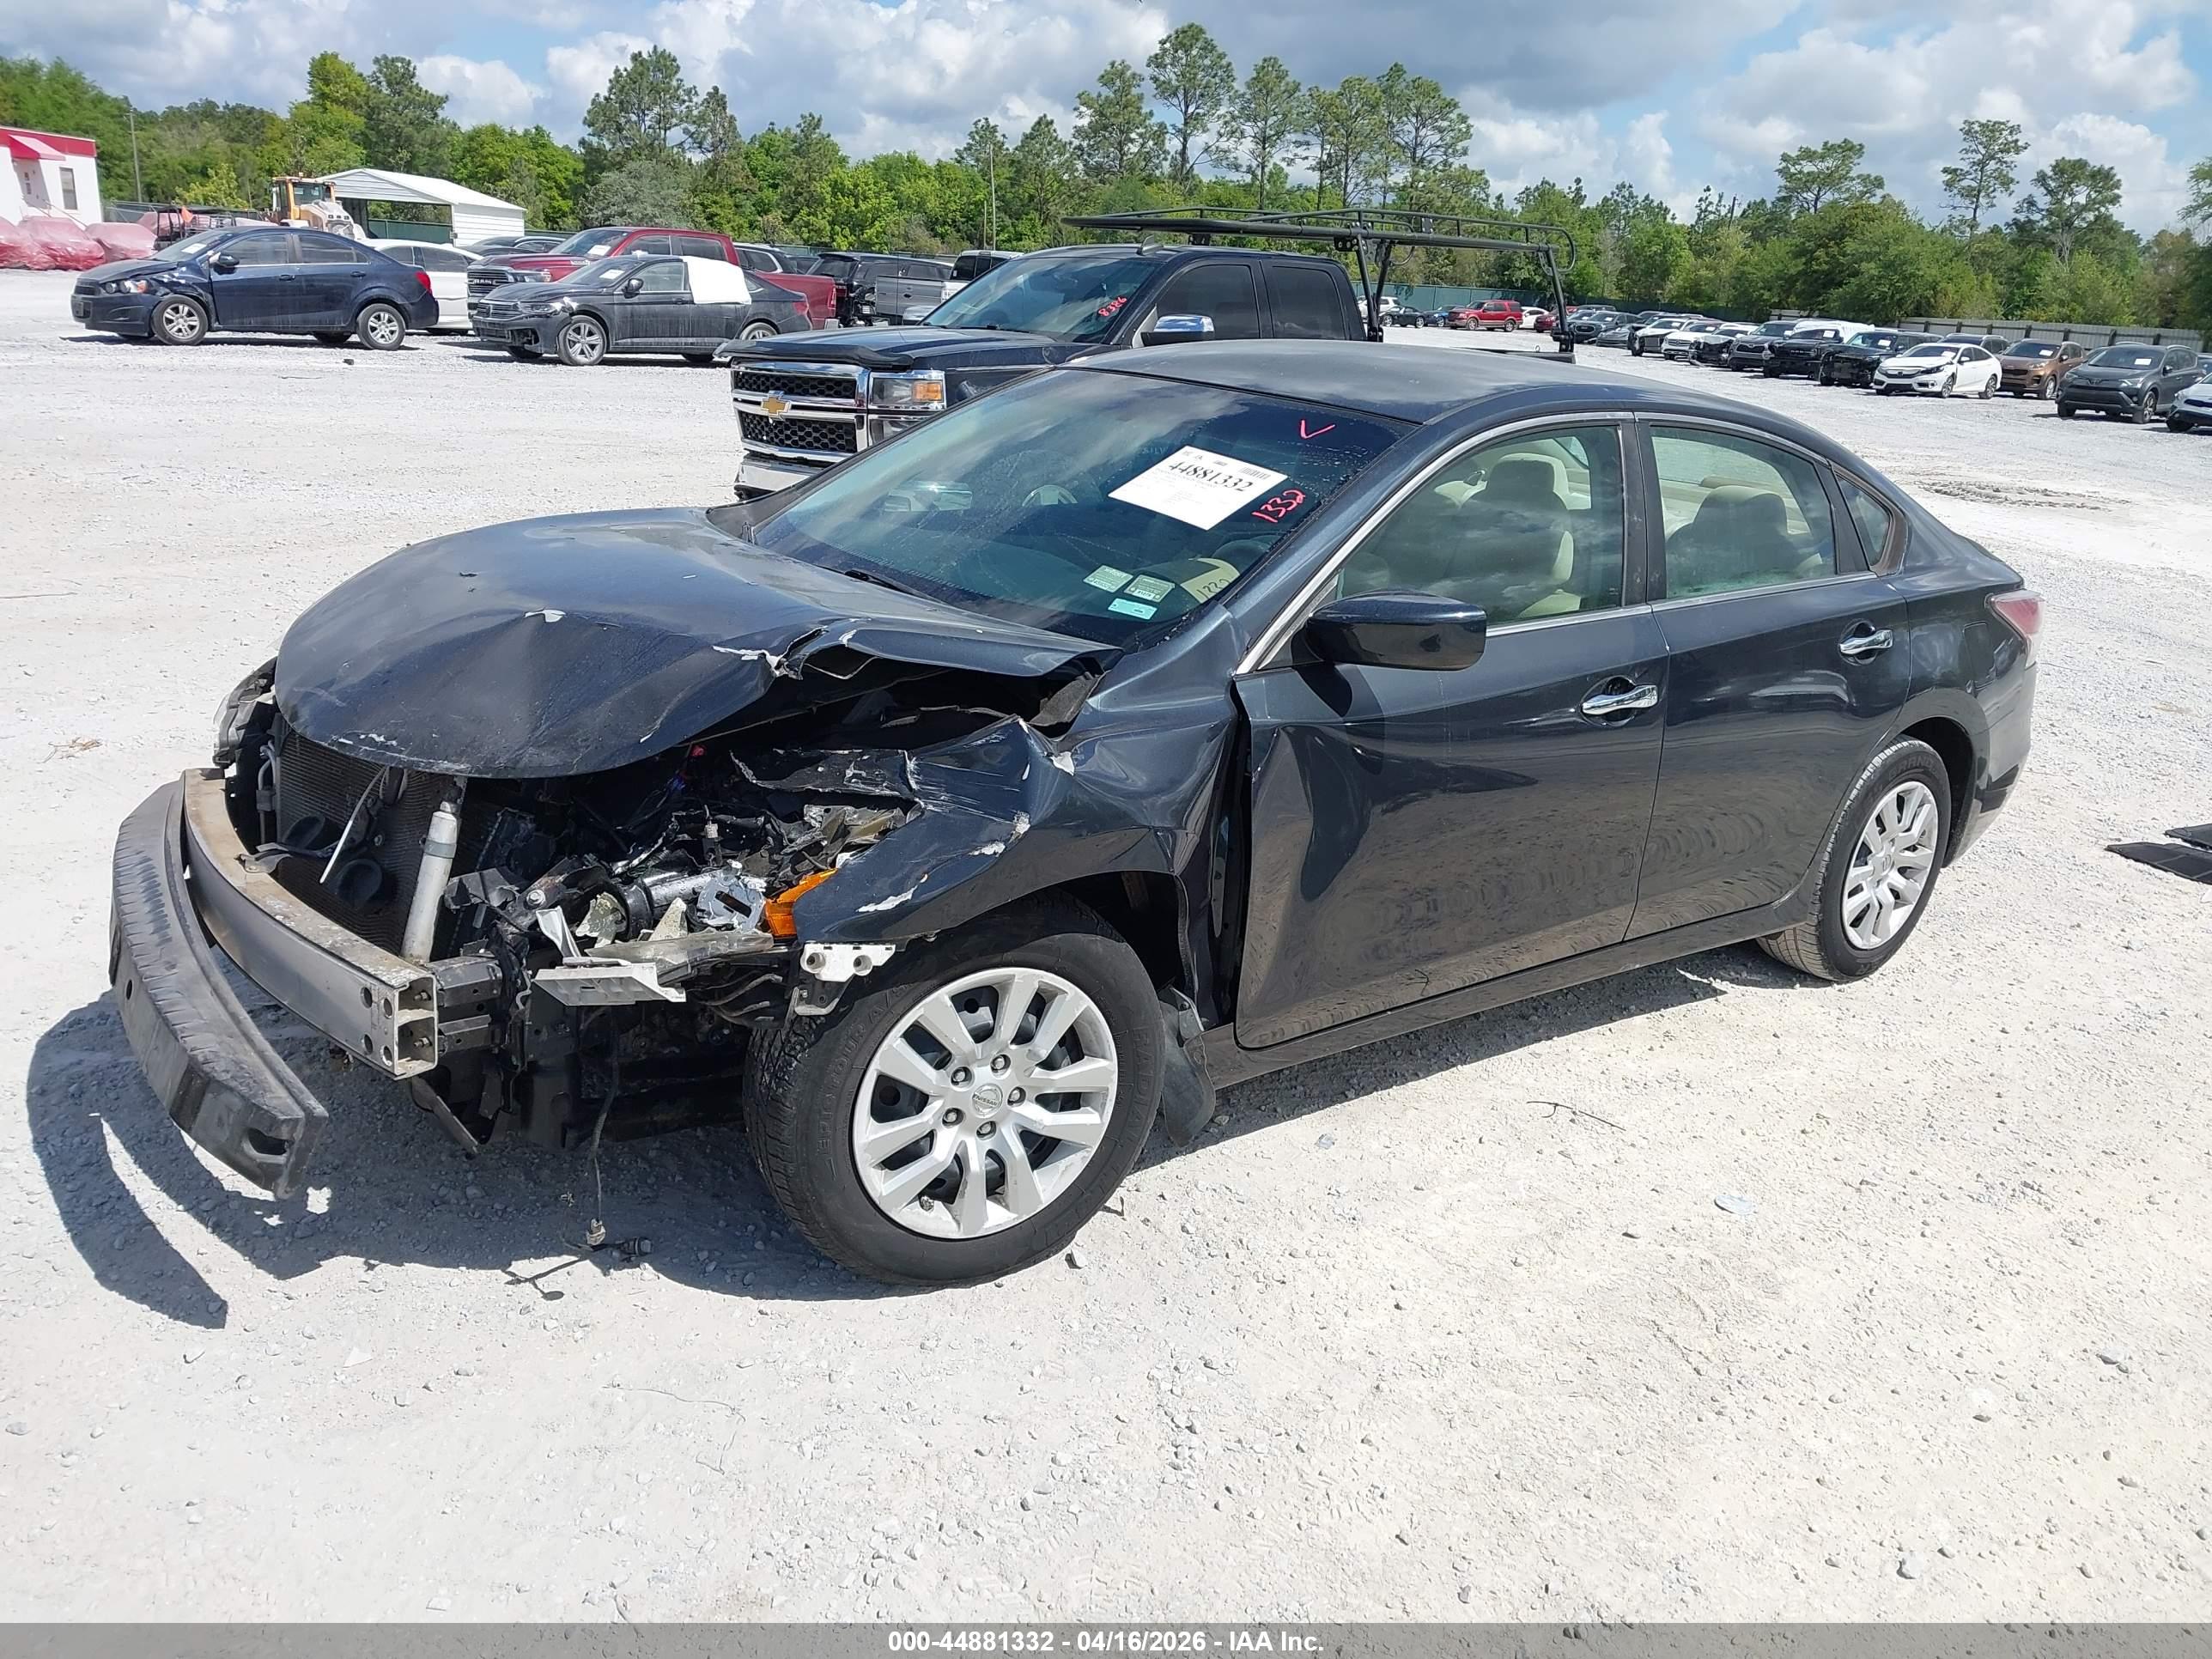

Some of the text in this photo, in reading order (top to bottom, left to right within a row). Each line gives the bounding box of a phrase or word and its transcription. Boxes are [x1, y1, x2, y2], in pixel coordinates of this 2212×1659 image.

[1169, 460, 1254, 492] 44881332
[1251, 489, 1306, 523] 1332
[975, 1094, 997, 1106] NISSAN
